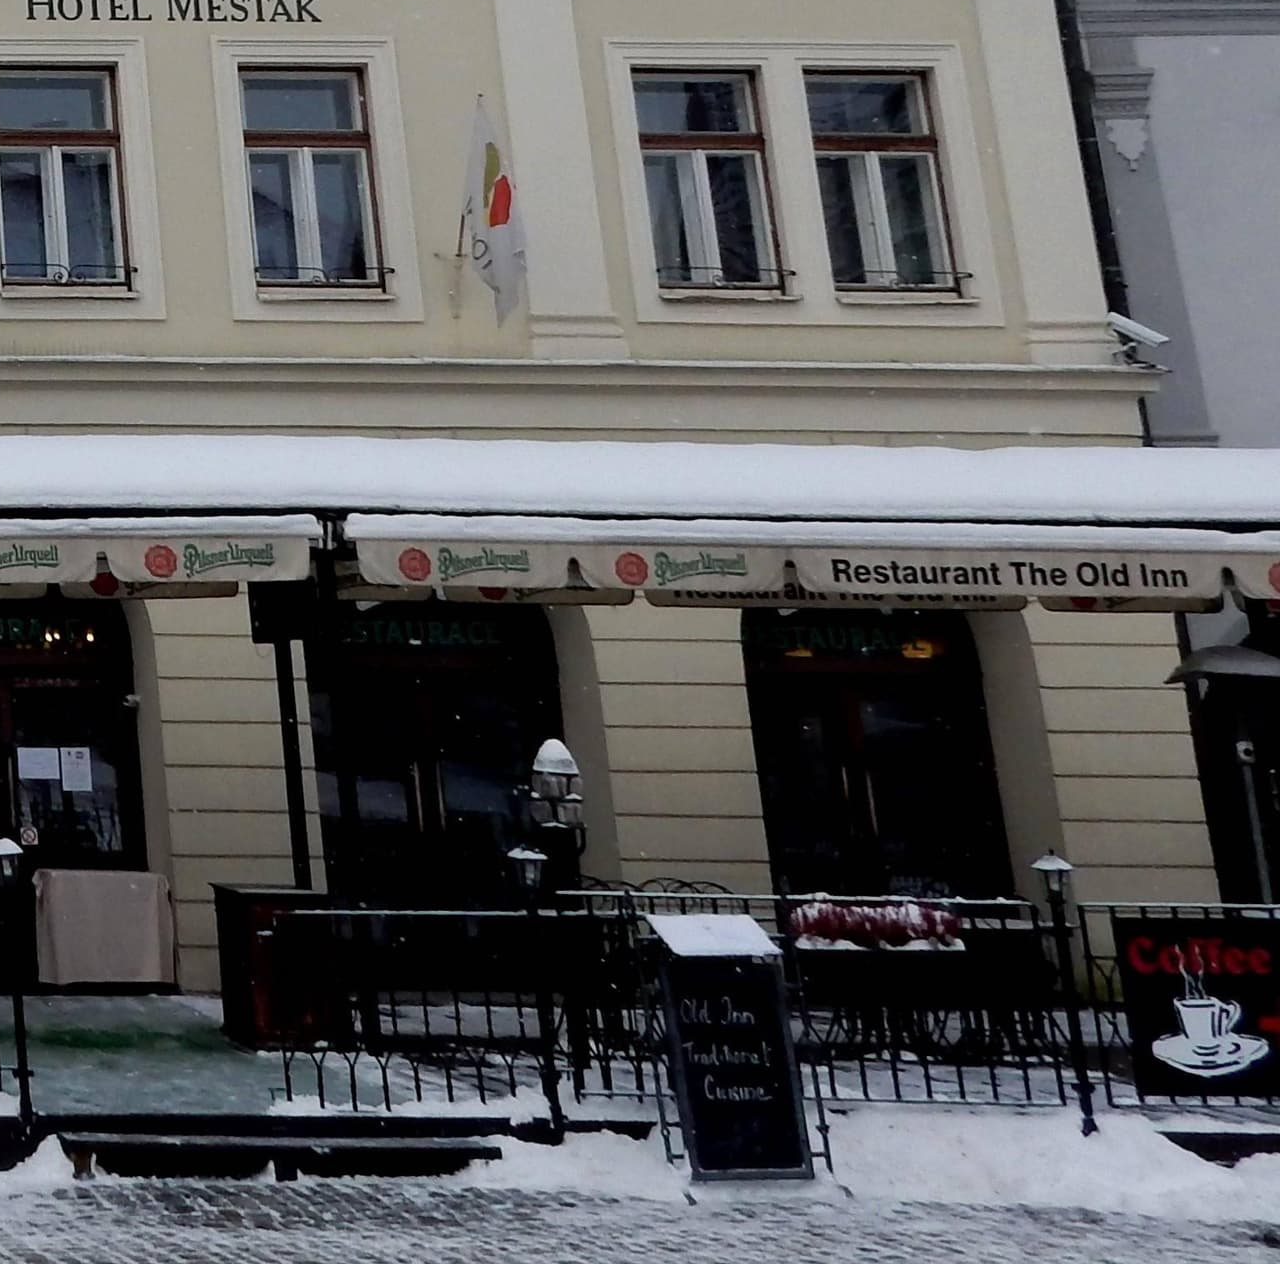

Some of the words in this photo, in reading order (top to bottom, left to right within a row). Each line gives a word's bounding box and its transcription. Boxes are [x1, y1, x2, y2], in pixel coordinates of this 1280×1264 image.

[13, 544, 58, 568] Urquell
[184, 544, 229, 578] Pilsner
[229, 543, 273, 568] Urquell
[438, 547, 484, 581] Pilsner
[482, 548, 529, 571] Urquell
[654, 551, 701, 586] Pilsner
[700, 552, 746, 576] Urquell
[831, 558, 1002, 586] Restaurant
[1008, 562, 1067, 587] The
[1077, 562, 1130, 587] Old
[1141, 563, 1188, 587] Inn
[1128, 936, 1272, 976] Coffee
[681, 998, 712, 1024] Old
[721, 996, 755, 1025] Inn
